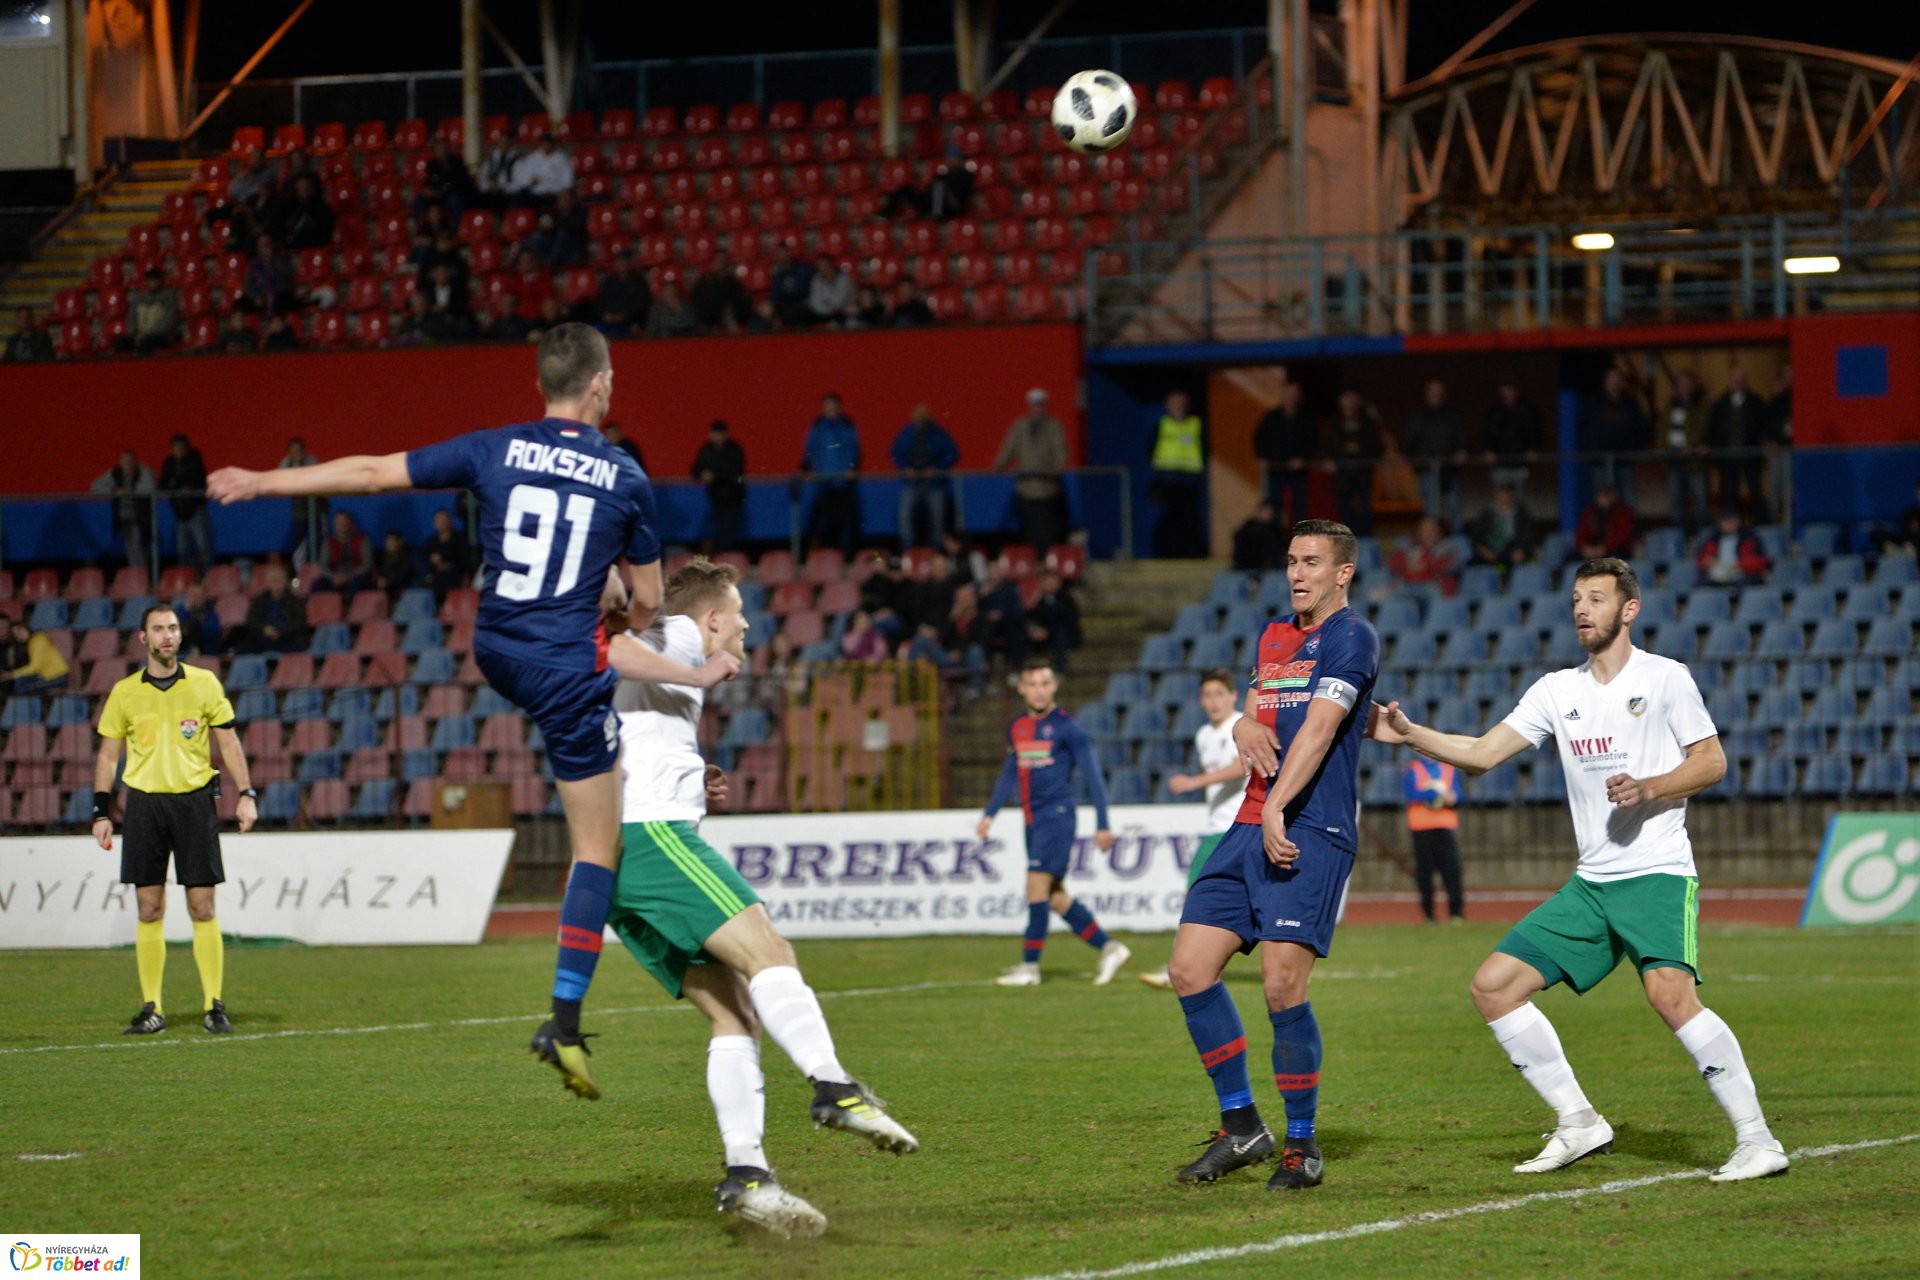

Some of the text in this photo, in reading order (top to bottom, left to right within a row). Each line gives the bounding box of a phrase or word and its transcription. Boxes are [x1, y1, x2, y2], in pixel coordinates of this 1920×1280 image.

[504, 438, 619, 491] ROKSZIN
[495, 483, 596, 602] 91
[1327, 681, 1344, 699] C
[1579, 751, 1628, 763] automotive
[732, 839, 1003, 886] BREKK
[0, 867, 438, 913] NYÍRYHÁZA
[930, 887, 968, 919] ÉS
